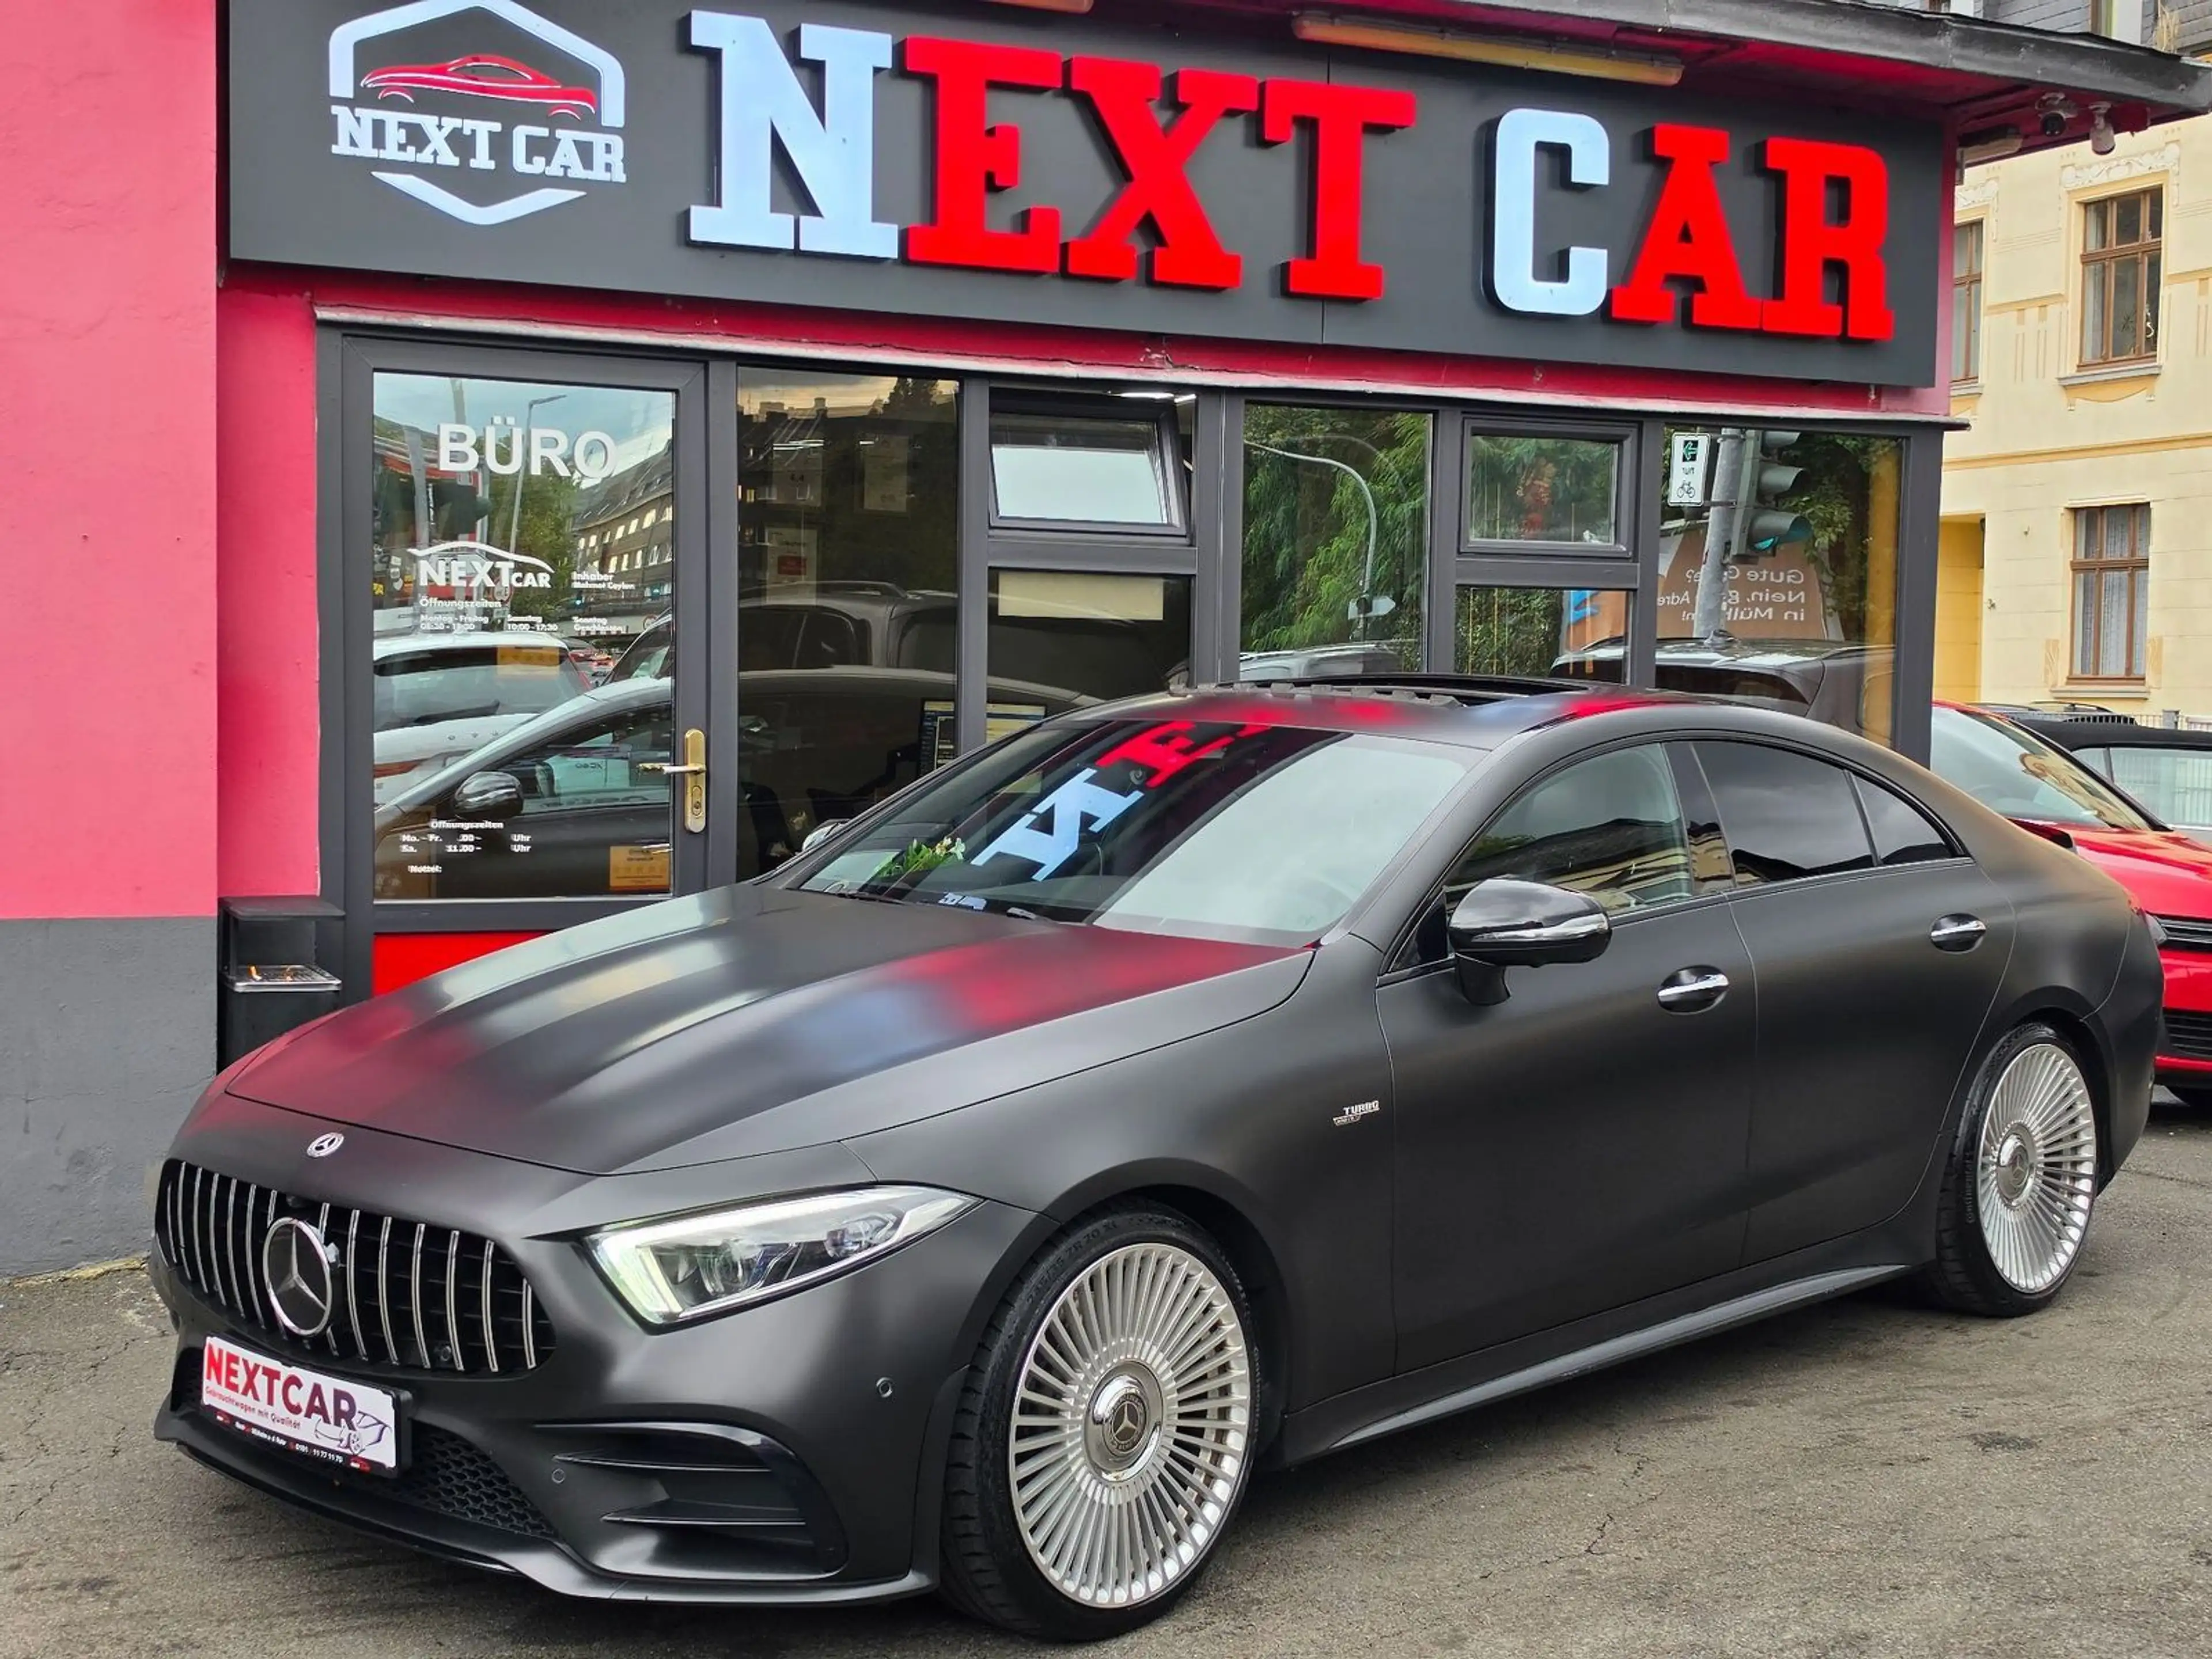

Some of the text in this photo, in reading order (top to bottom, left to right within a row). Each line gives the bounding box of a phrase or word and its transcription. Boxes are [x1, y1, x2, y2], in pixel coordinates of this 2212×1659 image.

[330, 105, 627, 183] NEXT CAR
[690, 9, 1895, 341] NEXT CAR
[438, 415, 616, 479] BÜRO
[206, 1343, 357, 1431] NEXTCAR
